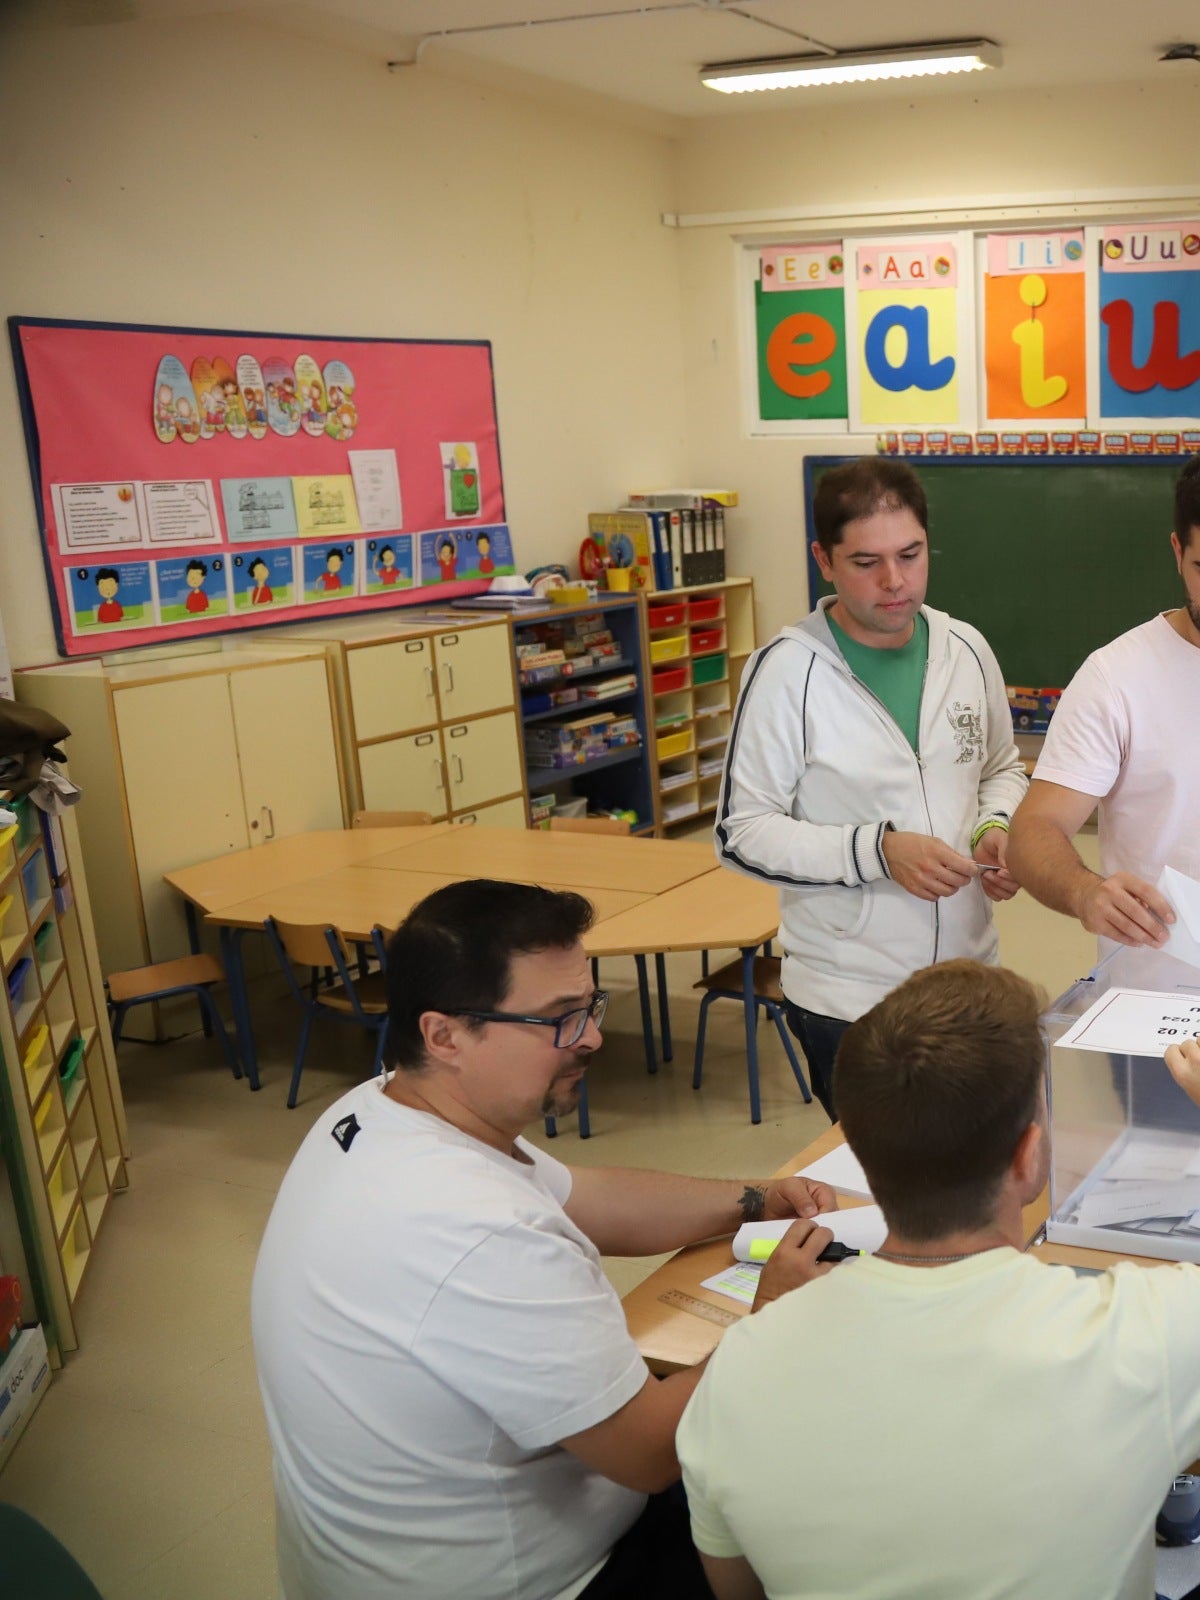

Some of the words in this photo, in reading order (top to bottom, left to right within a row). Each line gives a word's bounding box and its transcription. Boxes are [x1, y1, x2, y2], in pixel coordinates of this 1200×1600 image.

[766, 312, 837, 399] e
[865, 305, 955, 392] a
[1012, 275, 1067, 408] i
[1157, 1027, 1178, 1036] 02
[1161, 1015, 1190, 1023] 024
